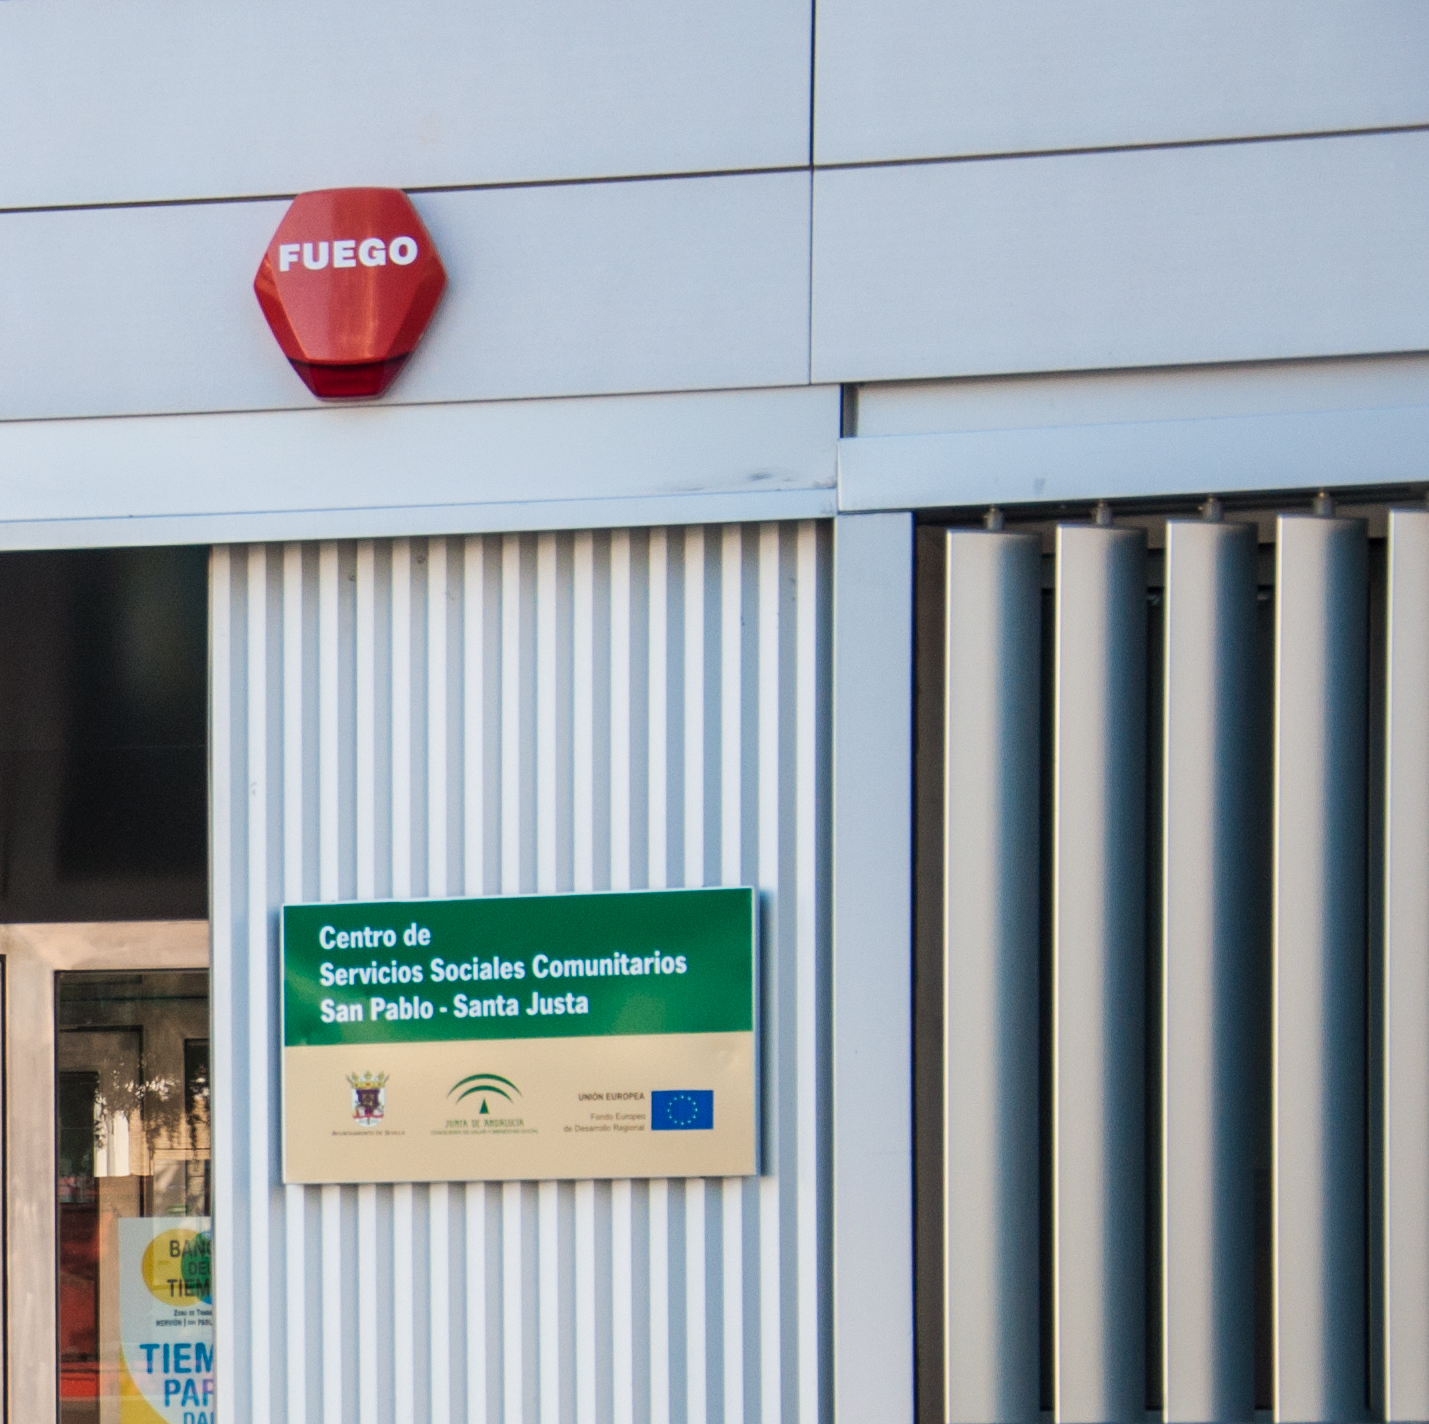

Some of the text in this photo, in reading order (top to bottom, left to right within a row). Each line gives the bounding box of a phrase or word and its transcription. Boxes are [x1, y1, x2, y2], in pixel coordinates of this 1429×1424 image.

[279, 236, 418, 272] FUEGO
[319, 922, 431, 949] Centro de
[320, 950, 688, 987] Servicios Sociales Comunitarios
[320, 998, 363, 1023] San
[370, 995, 433, 1021] Pablo
[453, 994, 519, 1018] Santa
[526, 991, 589, 1016] Justa
[606, 1092, 645, 1100] EUROPEA
